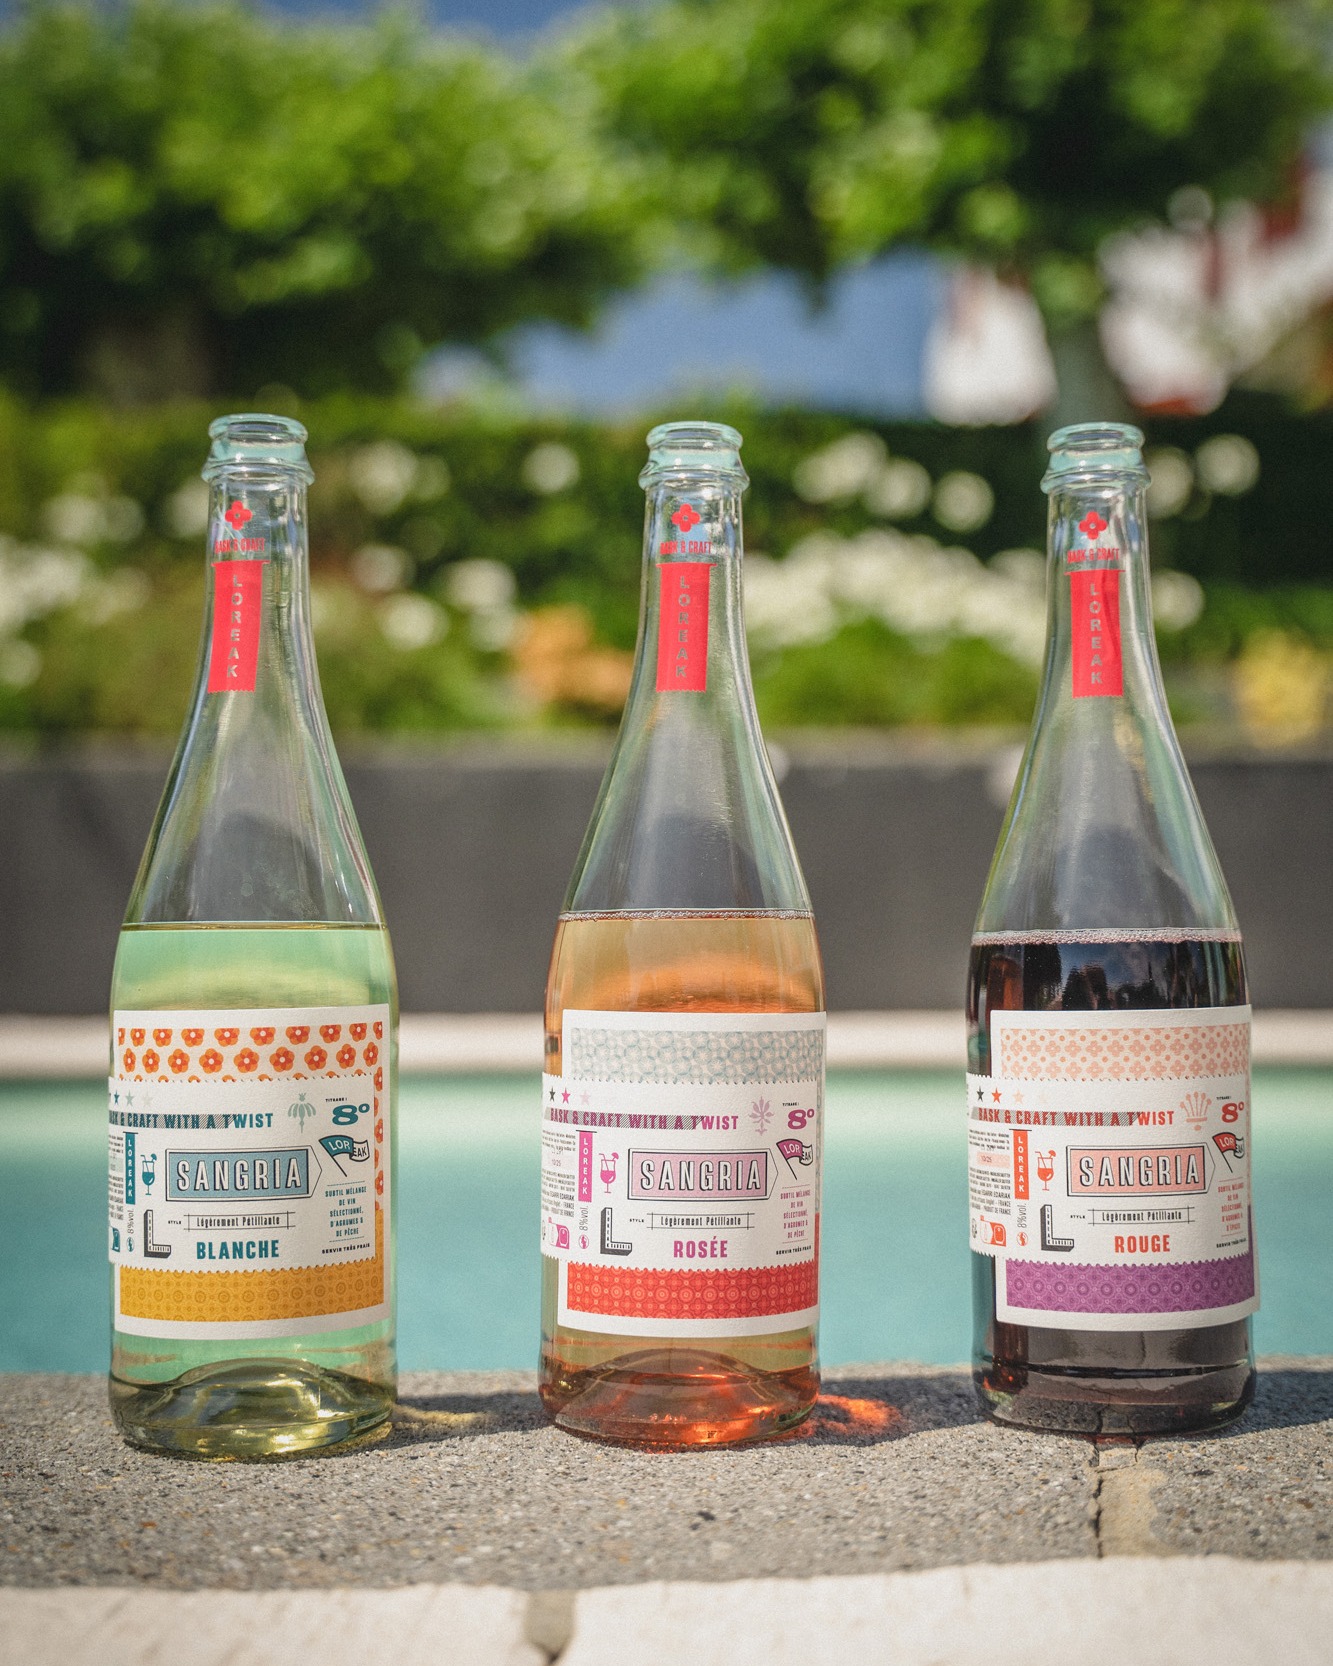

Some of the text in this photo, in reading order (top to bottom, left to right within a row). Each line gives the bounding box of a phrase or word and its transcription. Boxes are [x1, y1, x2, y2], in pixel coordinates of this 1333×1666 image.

[688, 540, 712, 555] CRAFT
[226, 575, 243, 678] LOREAK
[676, 576, 691, 678] LOREAK
[1089, 584, 1103, 685] LOREAK
[128, 1113, 158, 1128] CRAFT
[164, 1114, 199, 1129] WITH
[207, 1114, 216, 1129] A
[223, 1113, 273, 1129] TWIST
[550, 1108, 738, 1130] BASK & CRAFT WITH A TWIST
[978, 1107, 1174, 1127] BASK & CRAFT WITH A TWIST
[177, 1157, 302, 1192] SANGRIA
[640, 1159, 761, 1192] SANGRIA
[1080, 1154, 1199, 1187] SANGRIA
[325, 1186, 367, 1198] SUBTIL MÉLANGE
[197, 1216, 280, 1228] Légèrement Pétillante
[661, 1216, 741, 1228] Légèrement Pétillante
[1102, 1210, 1182, 1222] Légèrement Pétillante
[344, 1227, 359, 1236] PÊCHE
[197, 1240, 279, 1259] BLANCHE
[343, 1244, 356, 1252] TRÈS
[674, 1236, 728, 1258] ROSÉE
[1114, 1234, 1171, 1253] ROUGE
